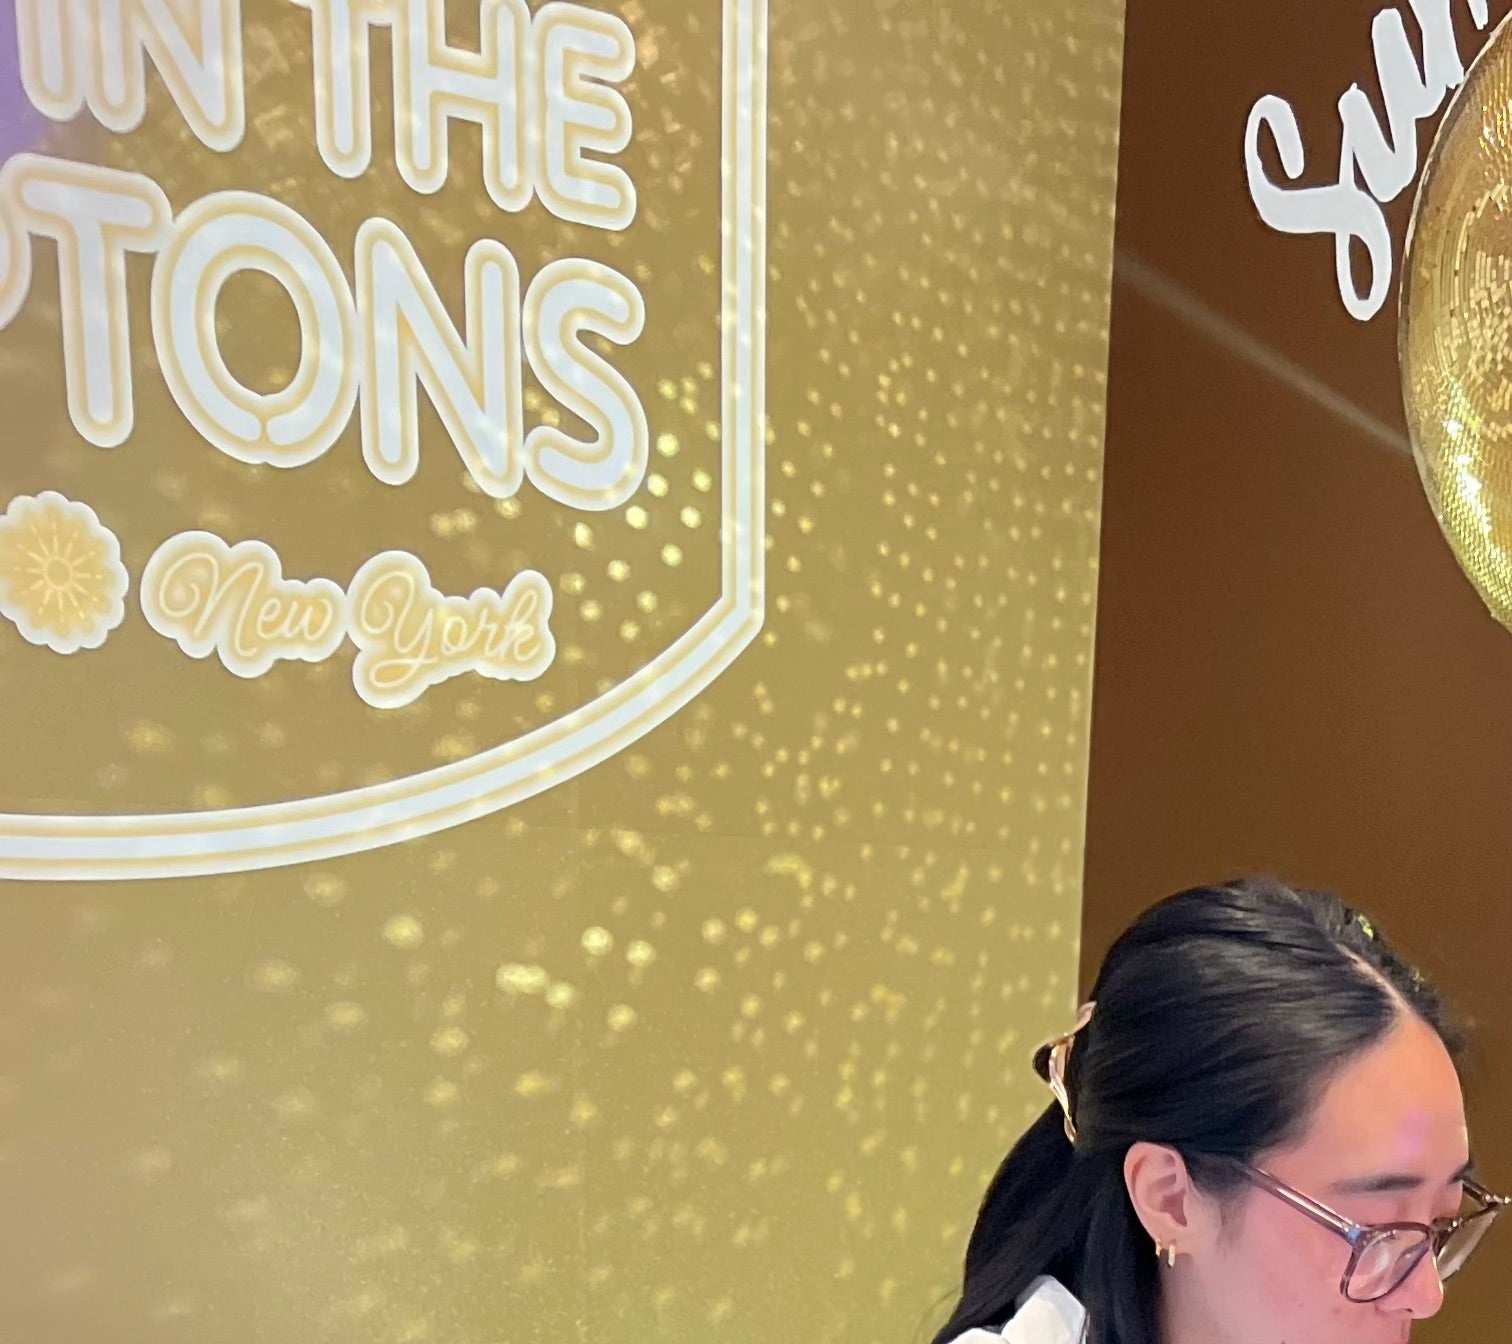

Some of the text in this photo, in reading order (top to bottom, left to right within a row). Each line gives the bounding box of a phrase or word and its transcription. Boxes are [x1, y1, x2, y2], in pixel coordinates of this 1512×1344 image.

[290, 0, 637, 231] THE
[150, 541, 549, 699] New York
